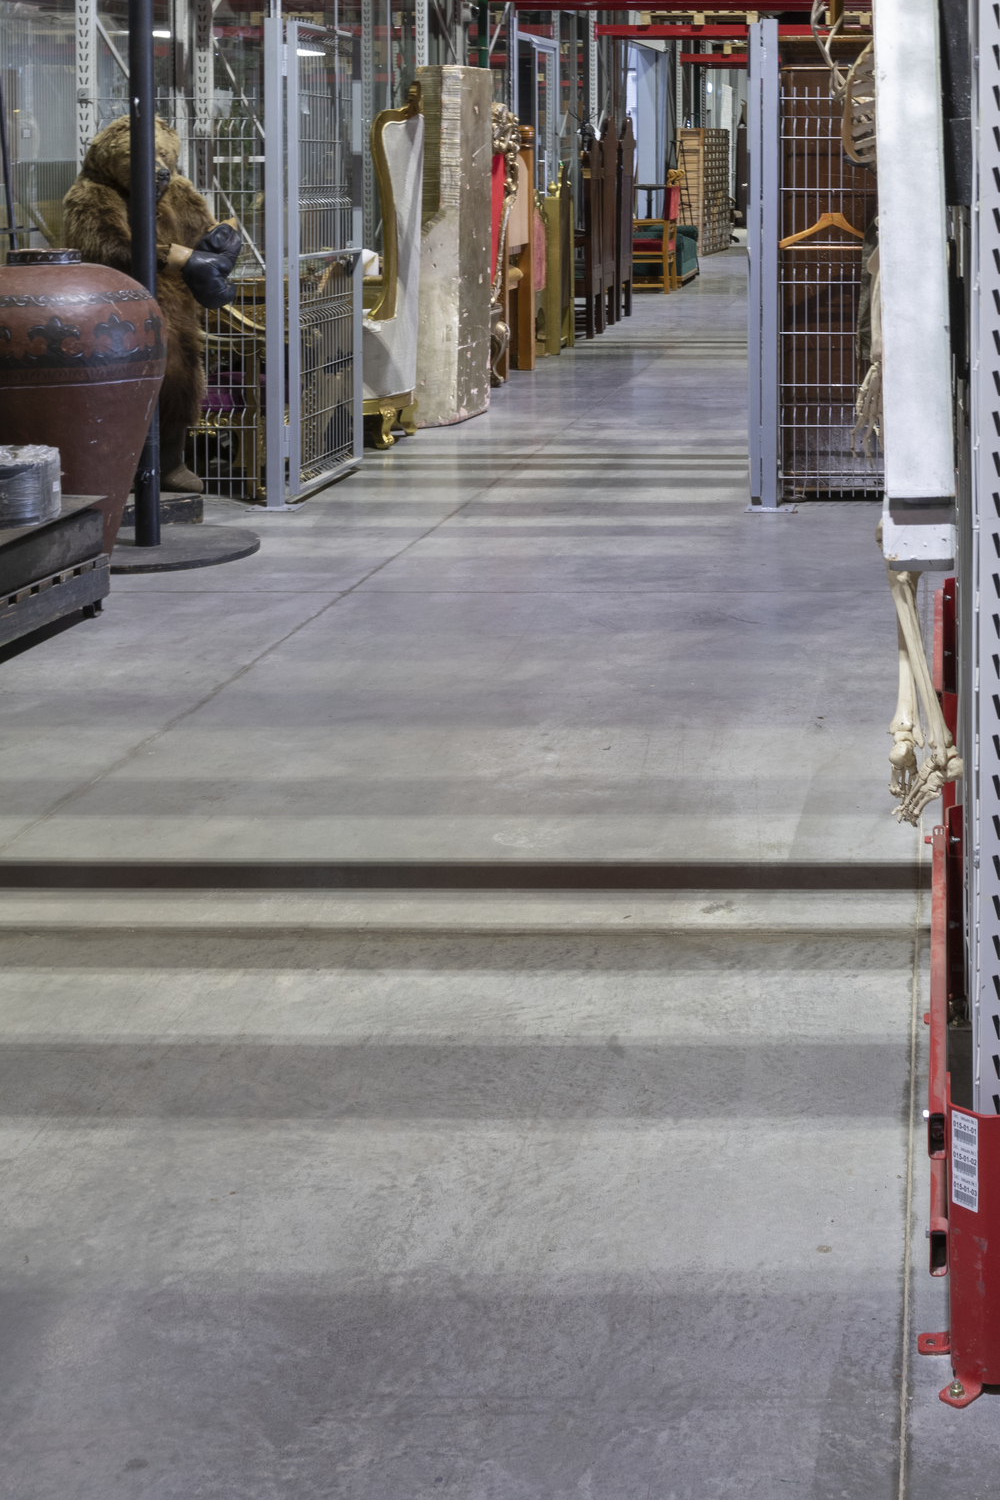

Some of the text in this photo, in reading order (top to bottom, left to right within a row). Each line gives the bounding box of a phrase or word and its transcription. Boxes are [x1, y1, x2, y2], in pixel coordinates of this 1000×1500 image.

[953, 1120, 977, 1135] 015-01-01
[953, 1151, 977, 1166] 015-01-02
[953, 1181, 977, 1197] 015-01-03
